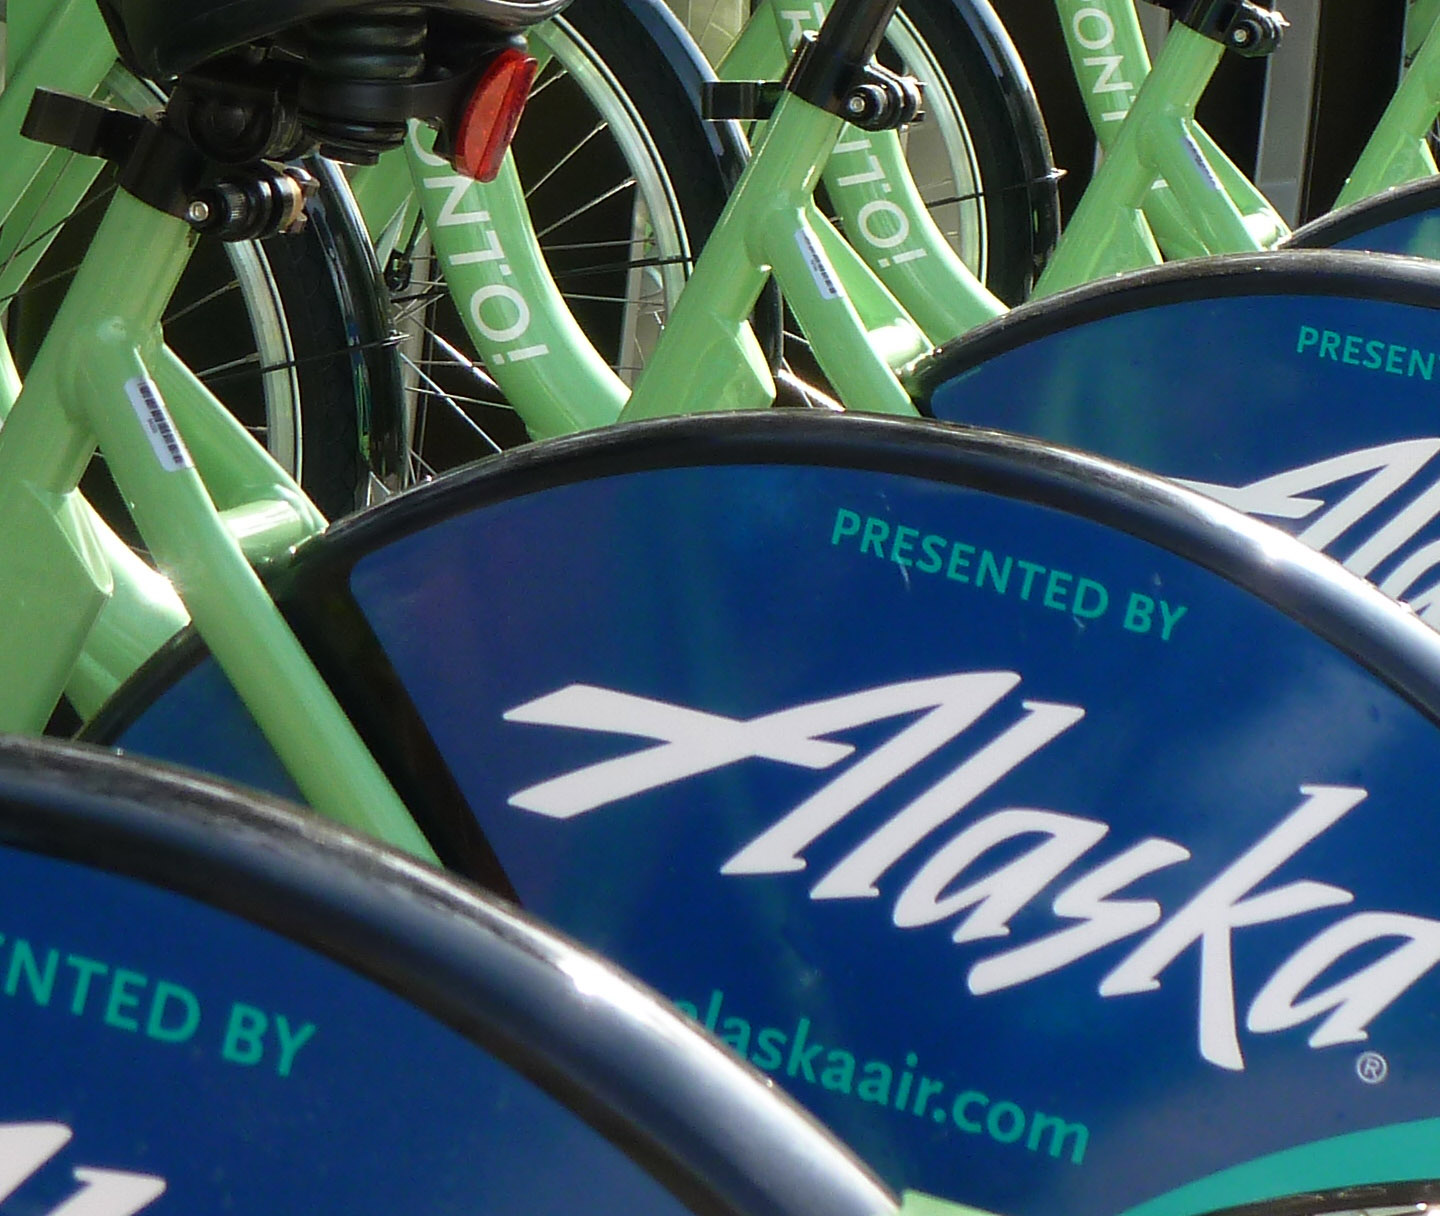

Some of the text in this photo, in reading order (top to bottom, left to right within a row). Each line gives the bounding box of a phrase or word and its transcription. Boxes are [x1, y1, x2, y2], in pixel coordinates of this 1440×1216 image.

[831, 508, 1189, 642] PRESENTED BY
[221, 1002, 319, 1081] BY
